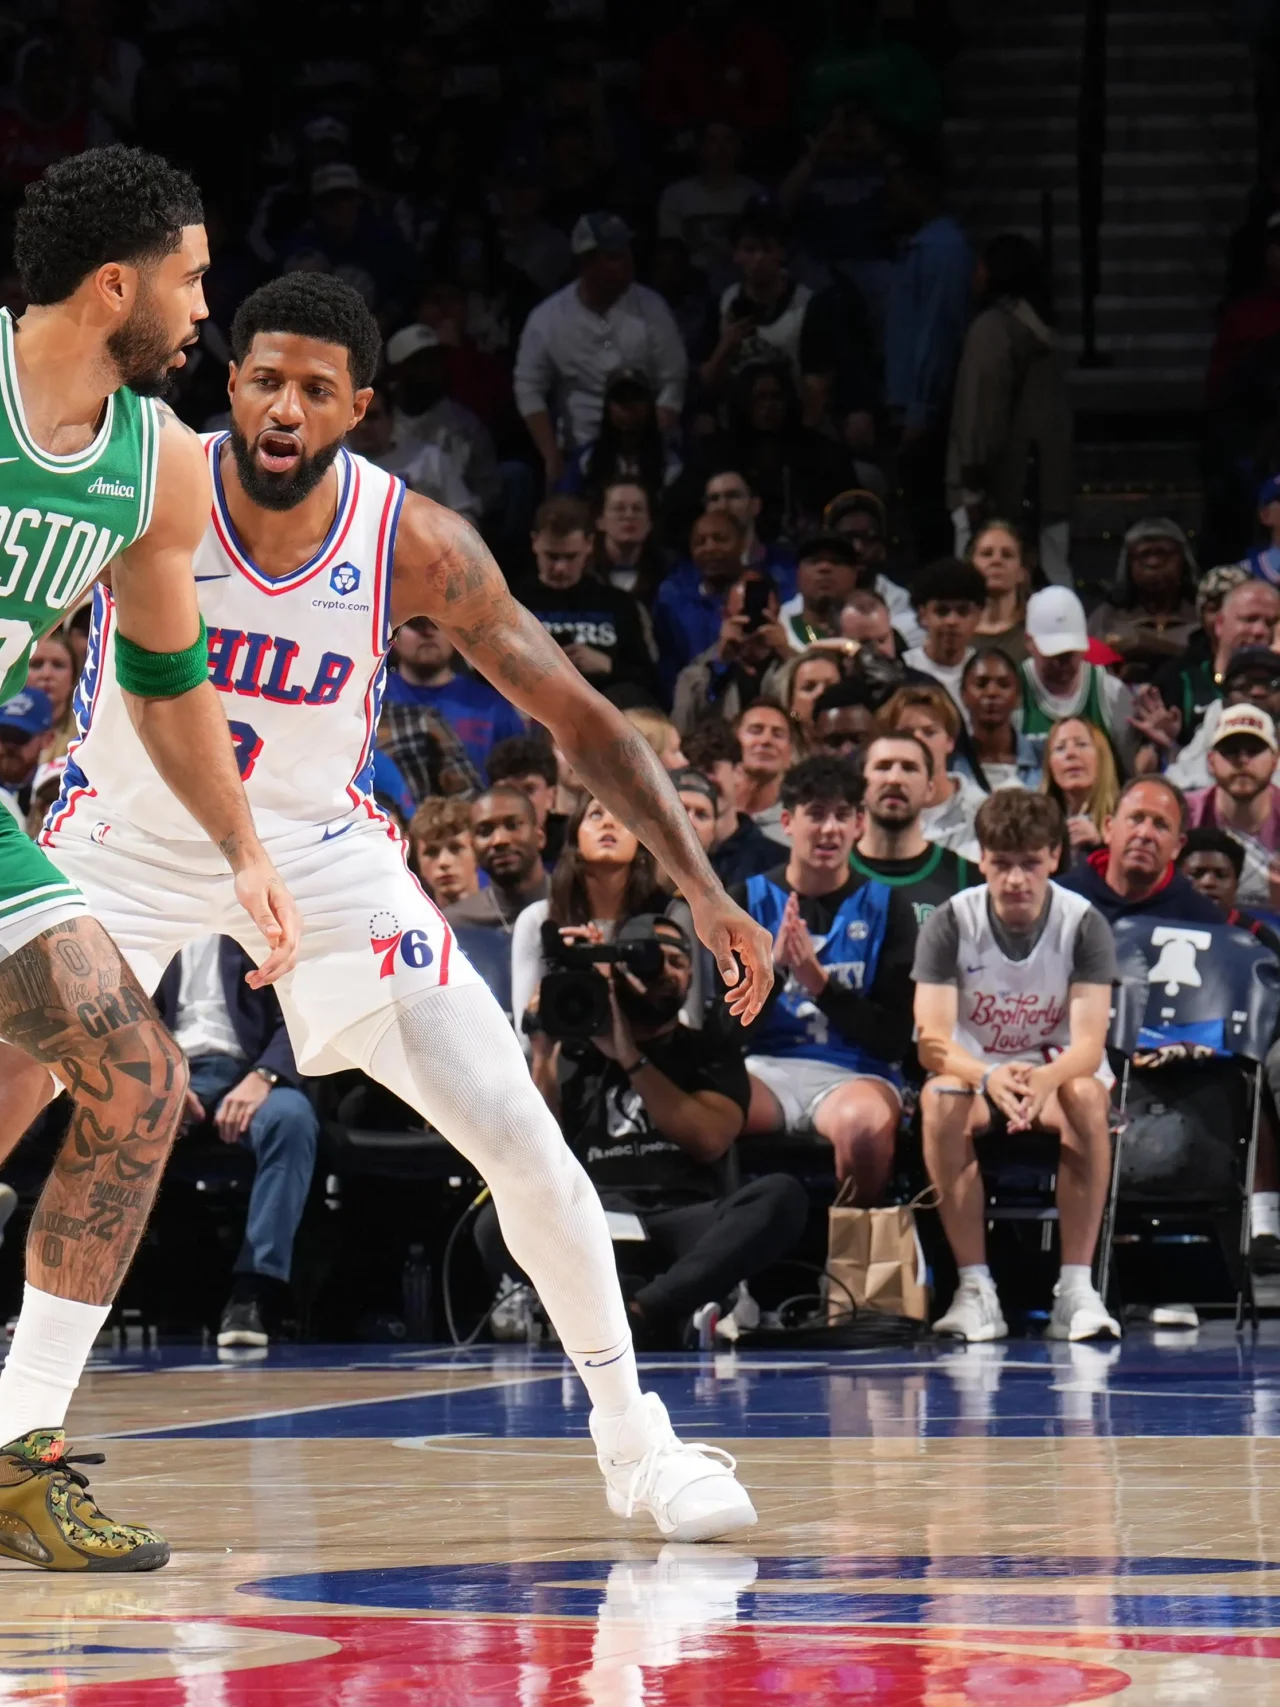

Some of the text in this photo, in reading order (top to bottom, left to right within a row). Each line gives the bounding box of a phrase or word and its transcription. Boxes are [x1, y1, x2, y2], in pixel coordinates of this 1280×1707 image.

[87, 476, 135, 499] Amica
[311, 598, 370, 613] crypto.com
[207, 626, 355, 706] HILA
[370, 929, 434, 980] 76
